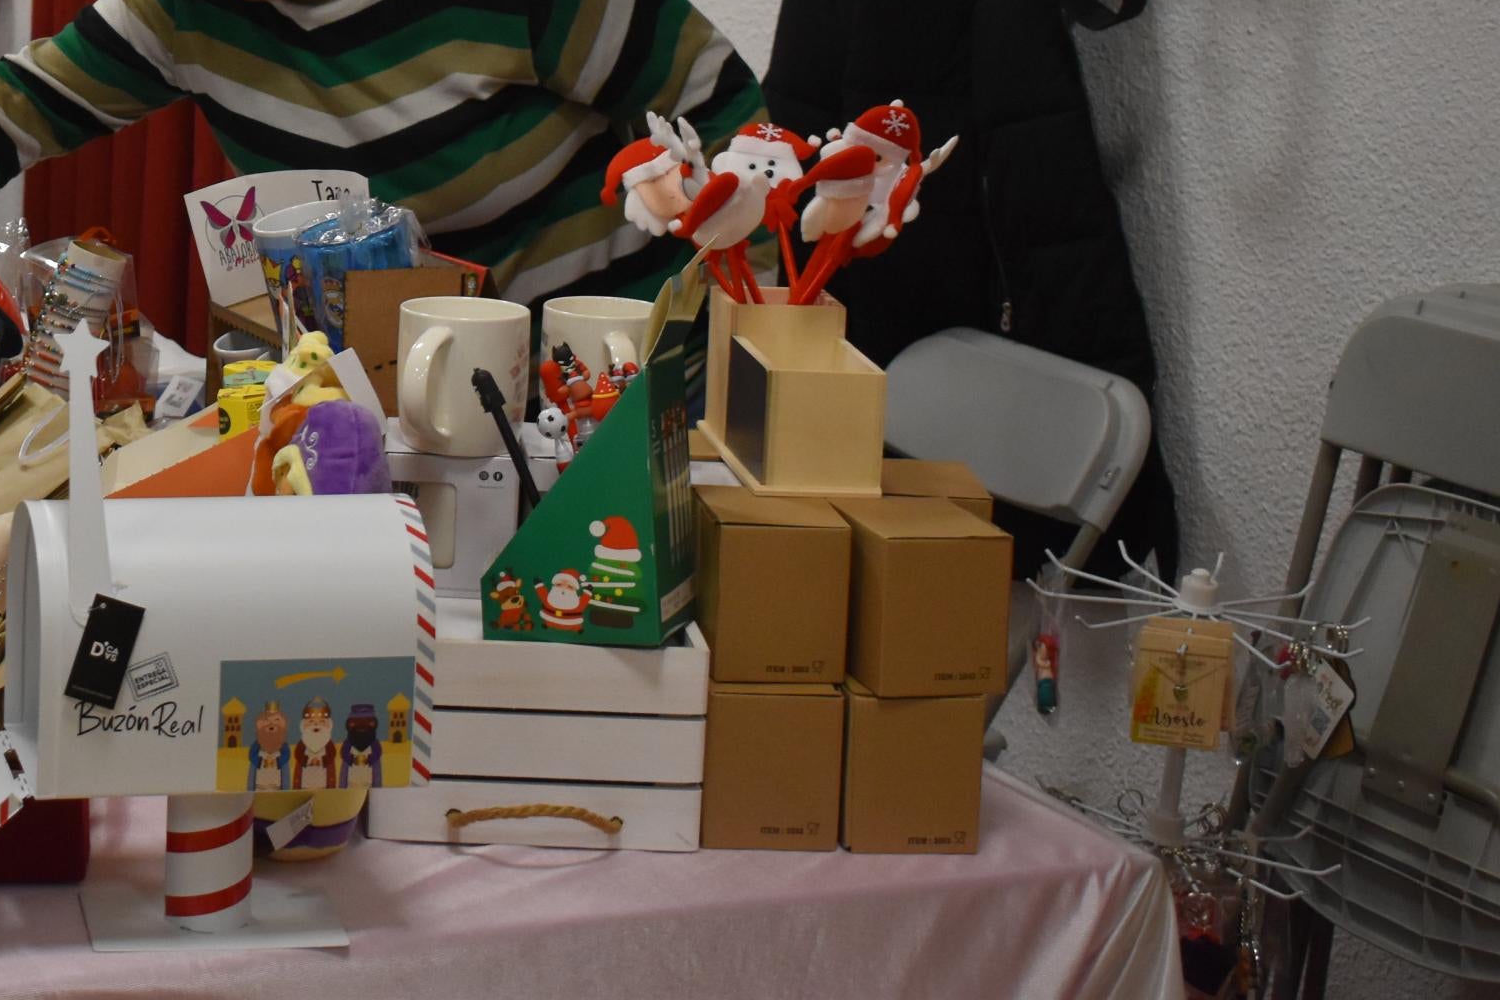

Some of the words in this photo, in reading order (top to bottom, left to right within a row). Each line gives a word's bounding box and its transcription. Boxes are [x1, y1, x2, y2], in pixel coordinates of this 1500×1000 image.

[134, 667, 168, 685] ENTREGA
[136, 675, 170, 691] ESPECIAL
[74, 701, 149, 737] Buzón
[151, 701, 204, 738] Real
